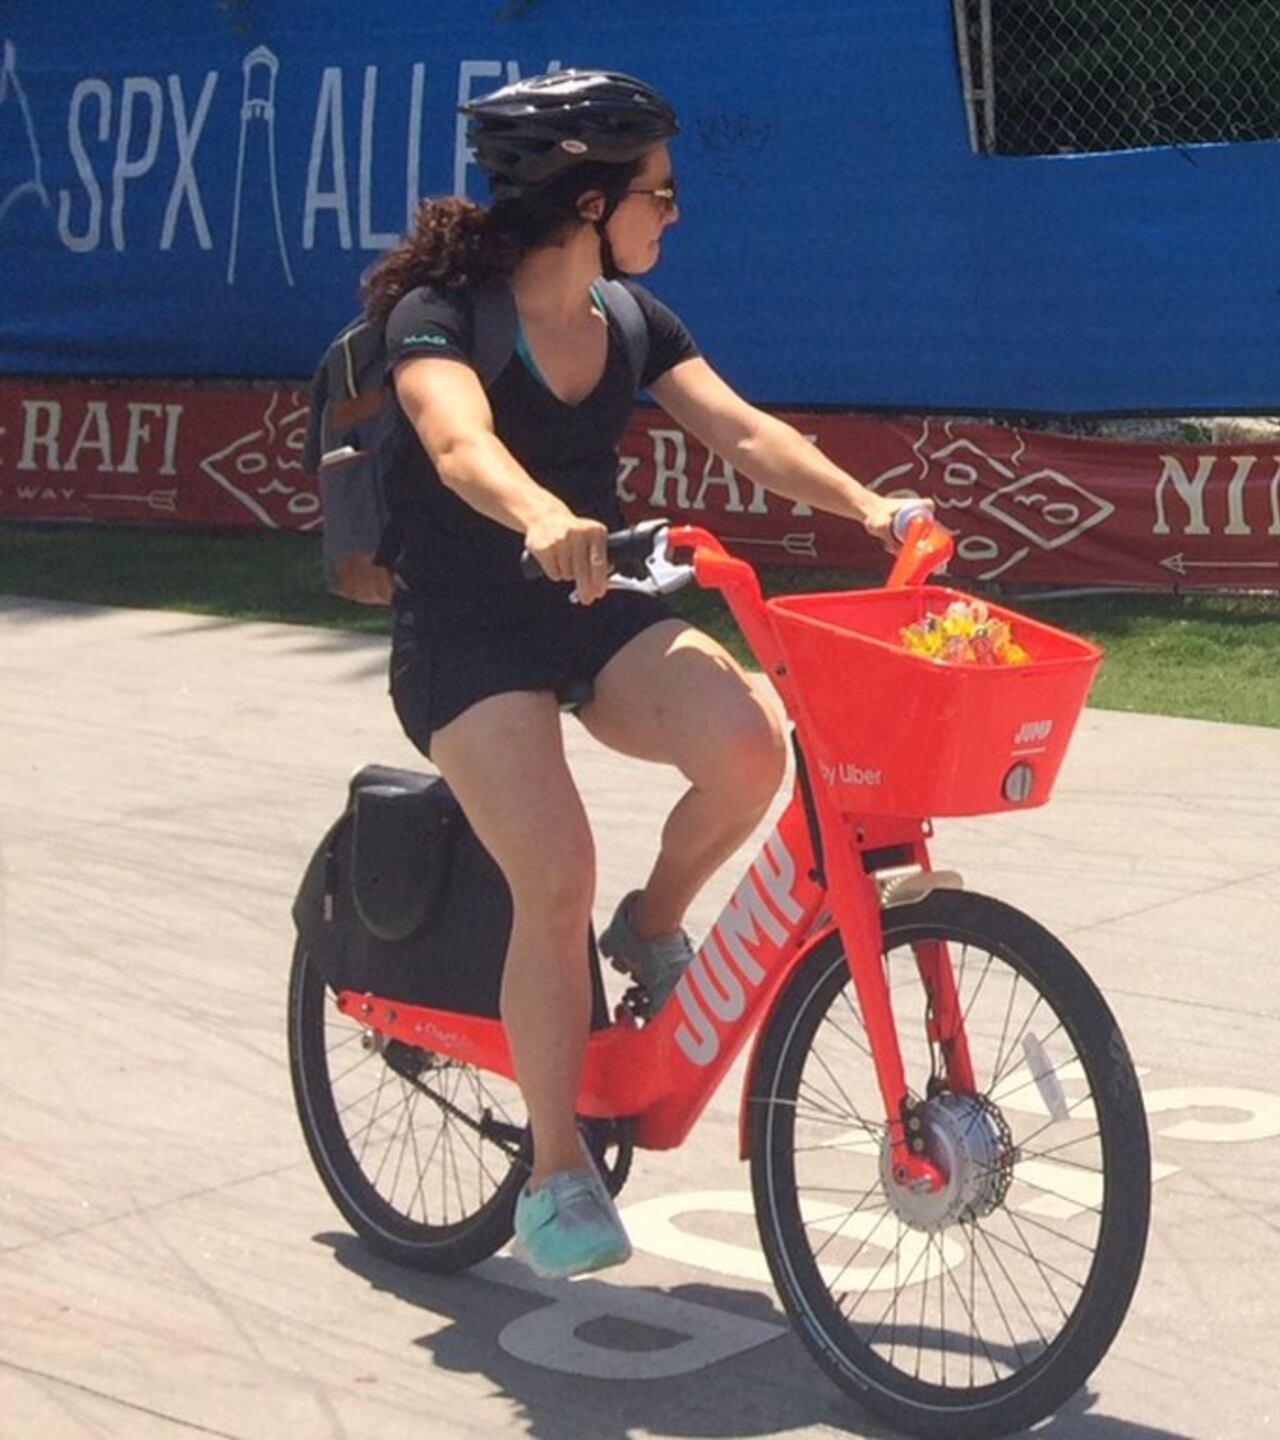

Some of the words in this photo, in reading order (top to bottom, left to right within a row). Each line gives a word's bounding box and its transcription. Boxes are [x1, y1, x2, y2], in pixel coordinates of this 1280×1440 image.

[57, 69, 218, 253] SPX
[302, 59, 562, 250] ALLE
[16, 399, 185, 476] RAFI
[647, 428, 819, 517] RA
[16, 486, 76, 500] WAY
[1014, 719, 1053, 745] JUMP
[838, 762, 883, 786] Uber
[673, 826, 807, 1067] JUMP
